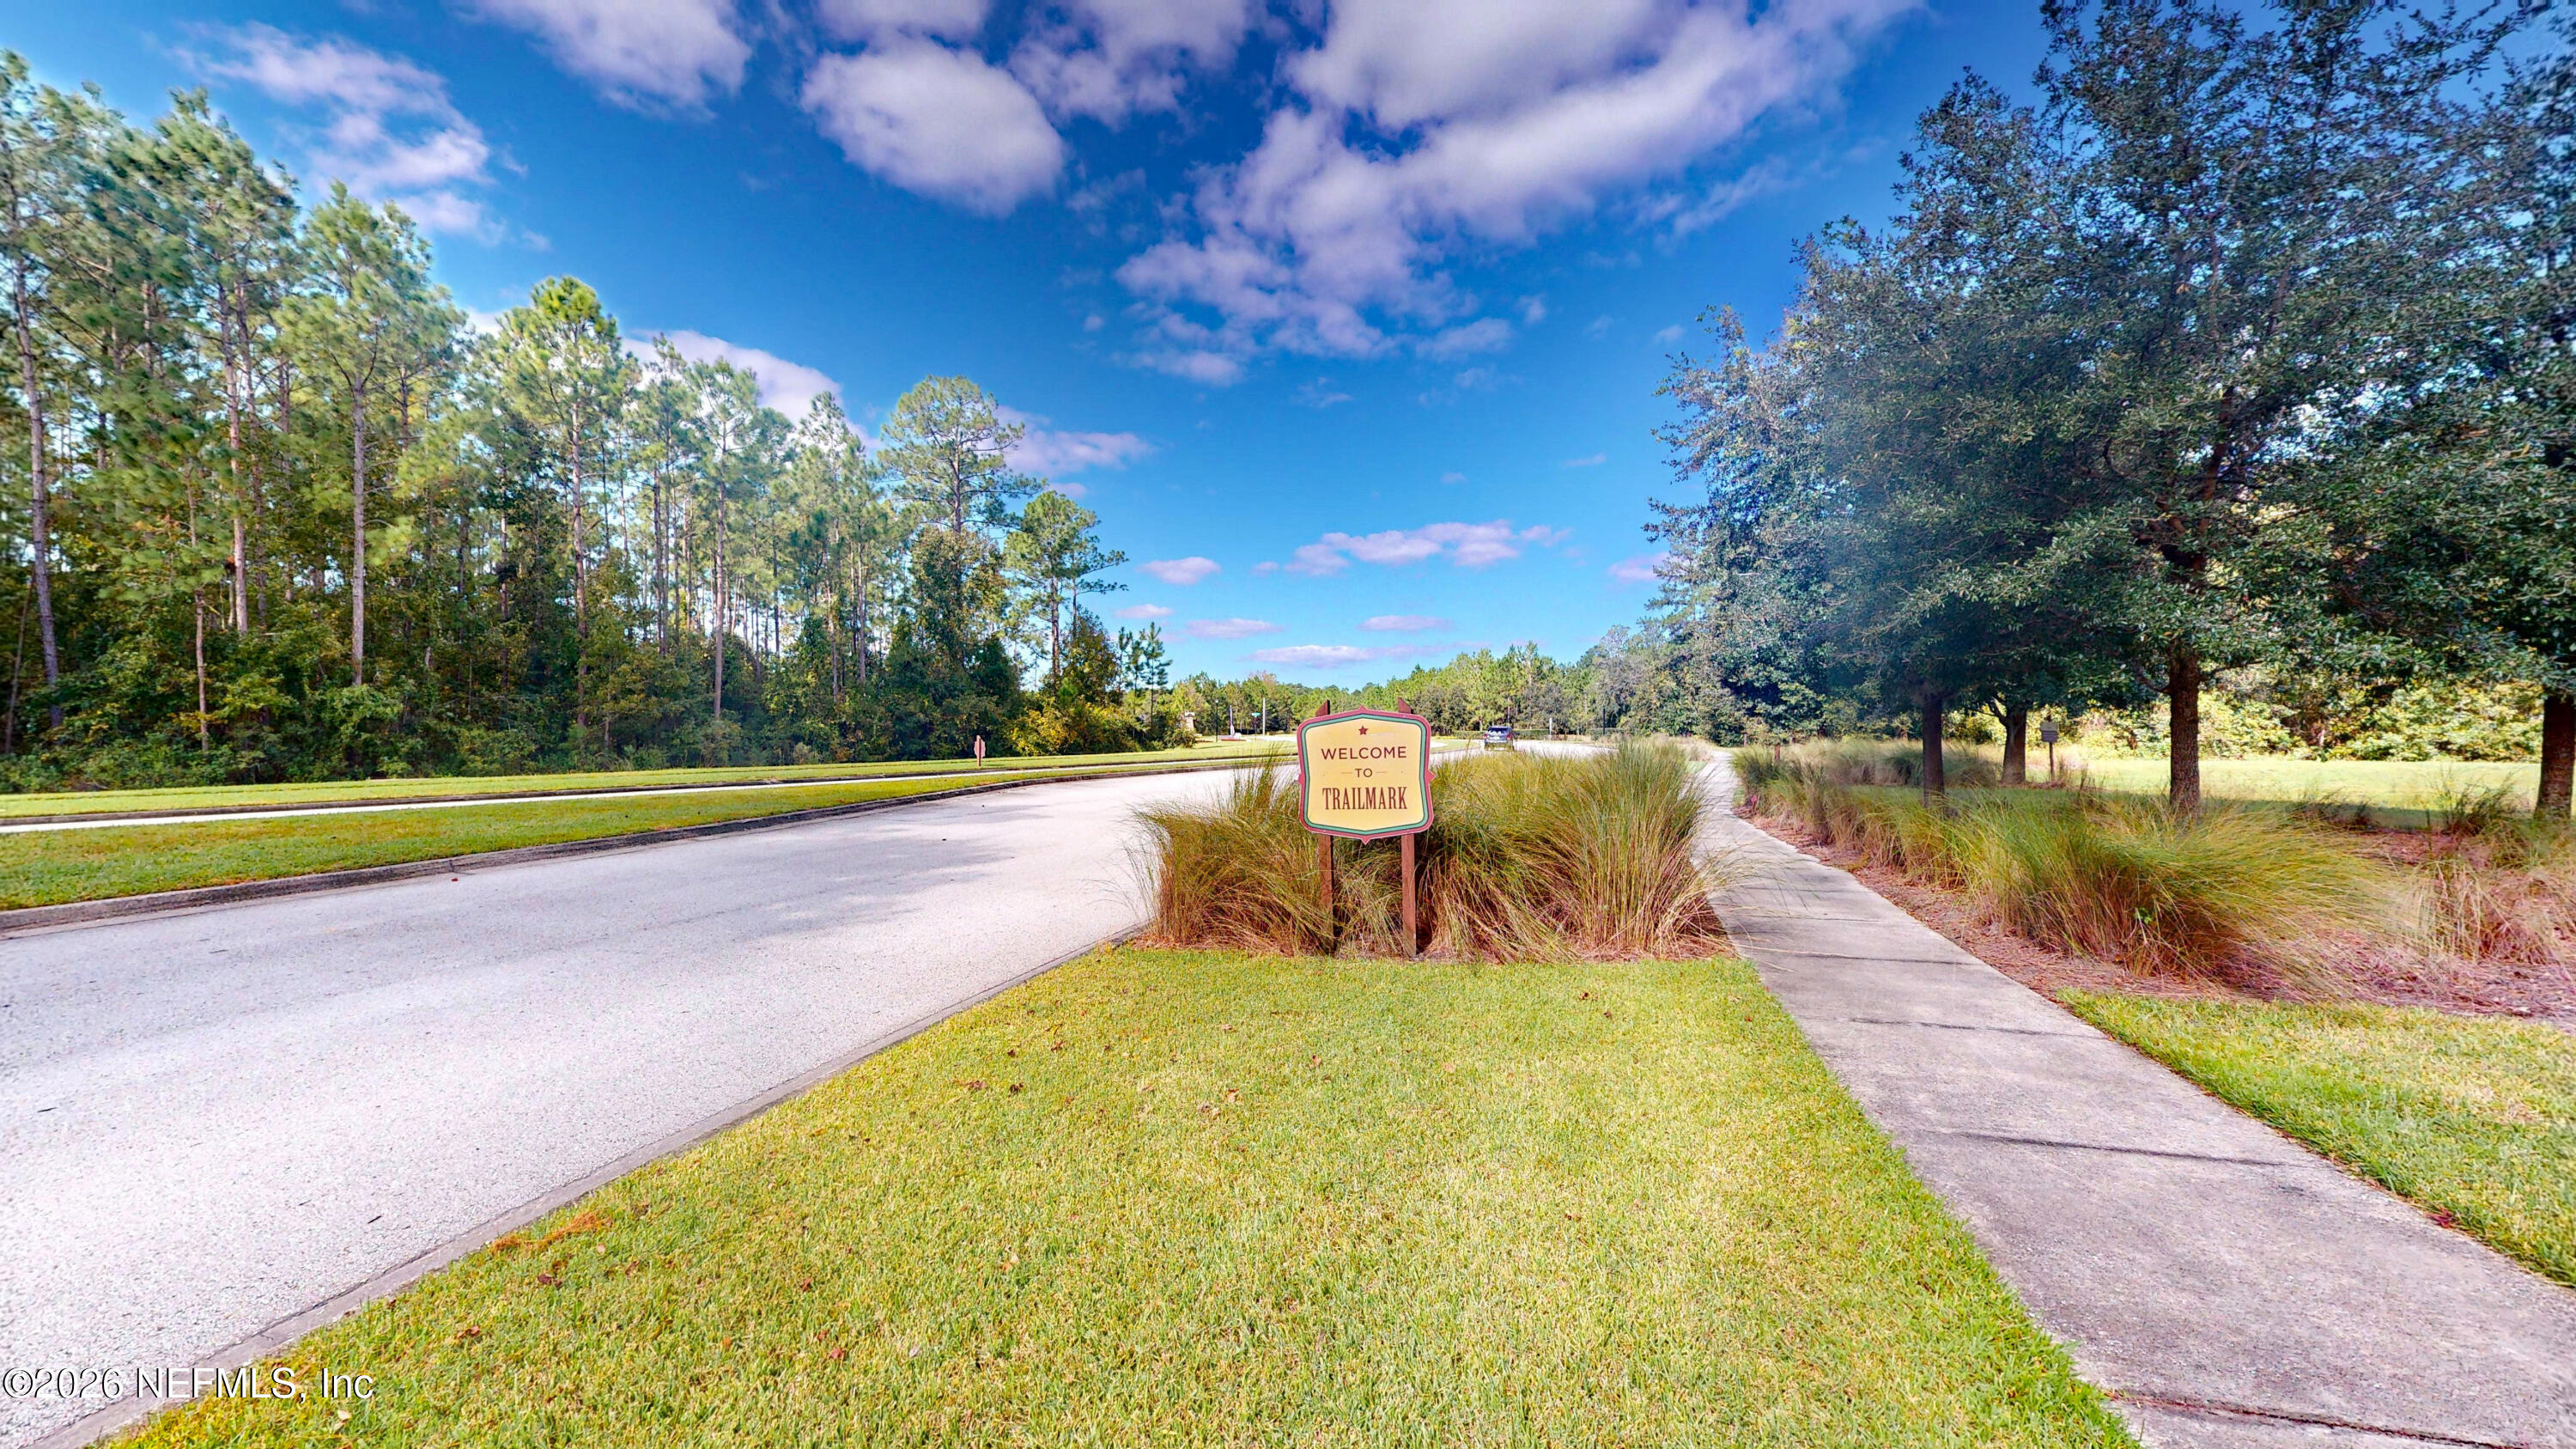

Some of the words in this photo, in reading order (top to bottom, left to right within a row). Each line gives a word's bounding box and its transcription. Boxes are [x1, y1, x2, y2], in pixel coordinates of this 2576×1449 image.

[1321, 746, 1406, 759] WELCOME
[1355, 768, 1373, 778] TO
[1322, 787, 1407, 810] TRAILMARK
